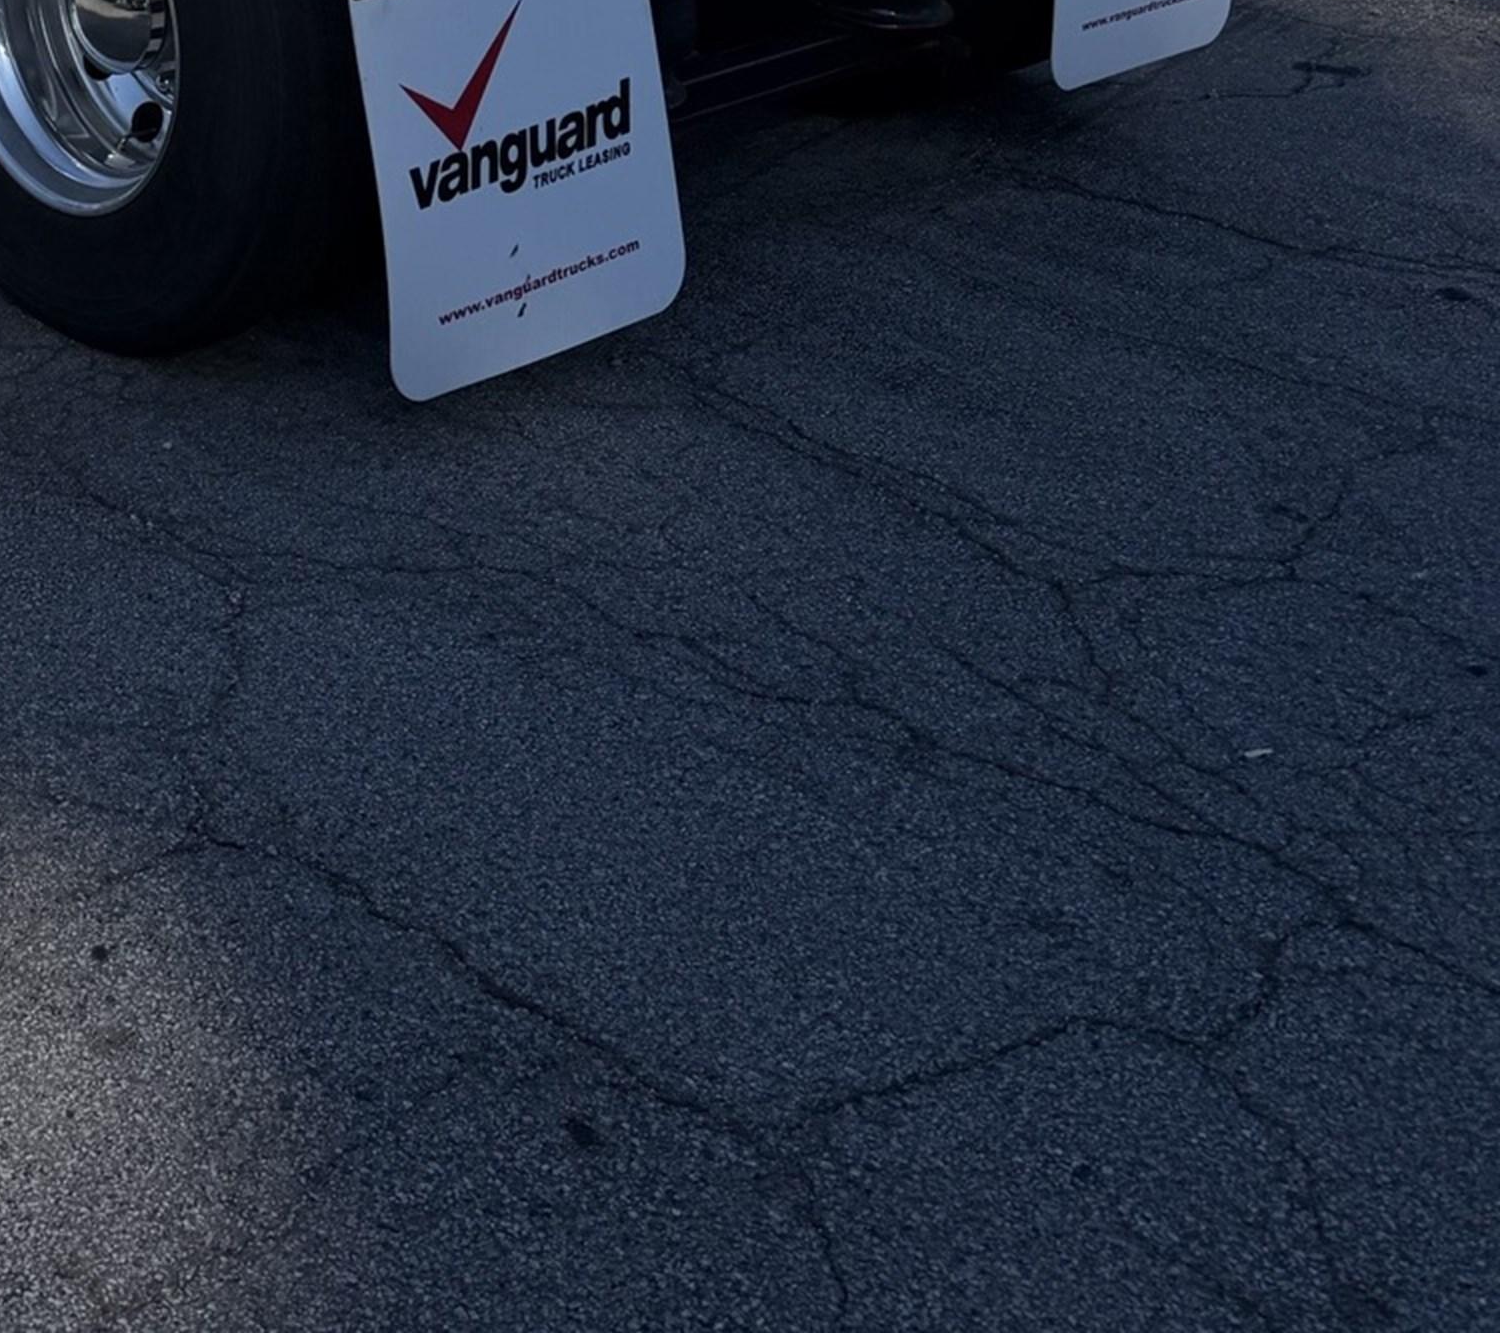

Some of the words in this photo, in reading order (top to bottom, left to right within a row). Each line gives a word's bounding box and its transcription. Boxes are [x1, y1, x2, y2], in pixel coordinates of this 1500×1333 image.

[409, 76, 631, 210] vanguard
[532, 162, 576, 190] TRUCK
[577, 141, 631, 174] LEASING
[438, 239, 641, 326] www.vanguardtrucks.com
